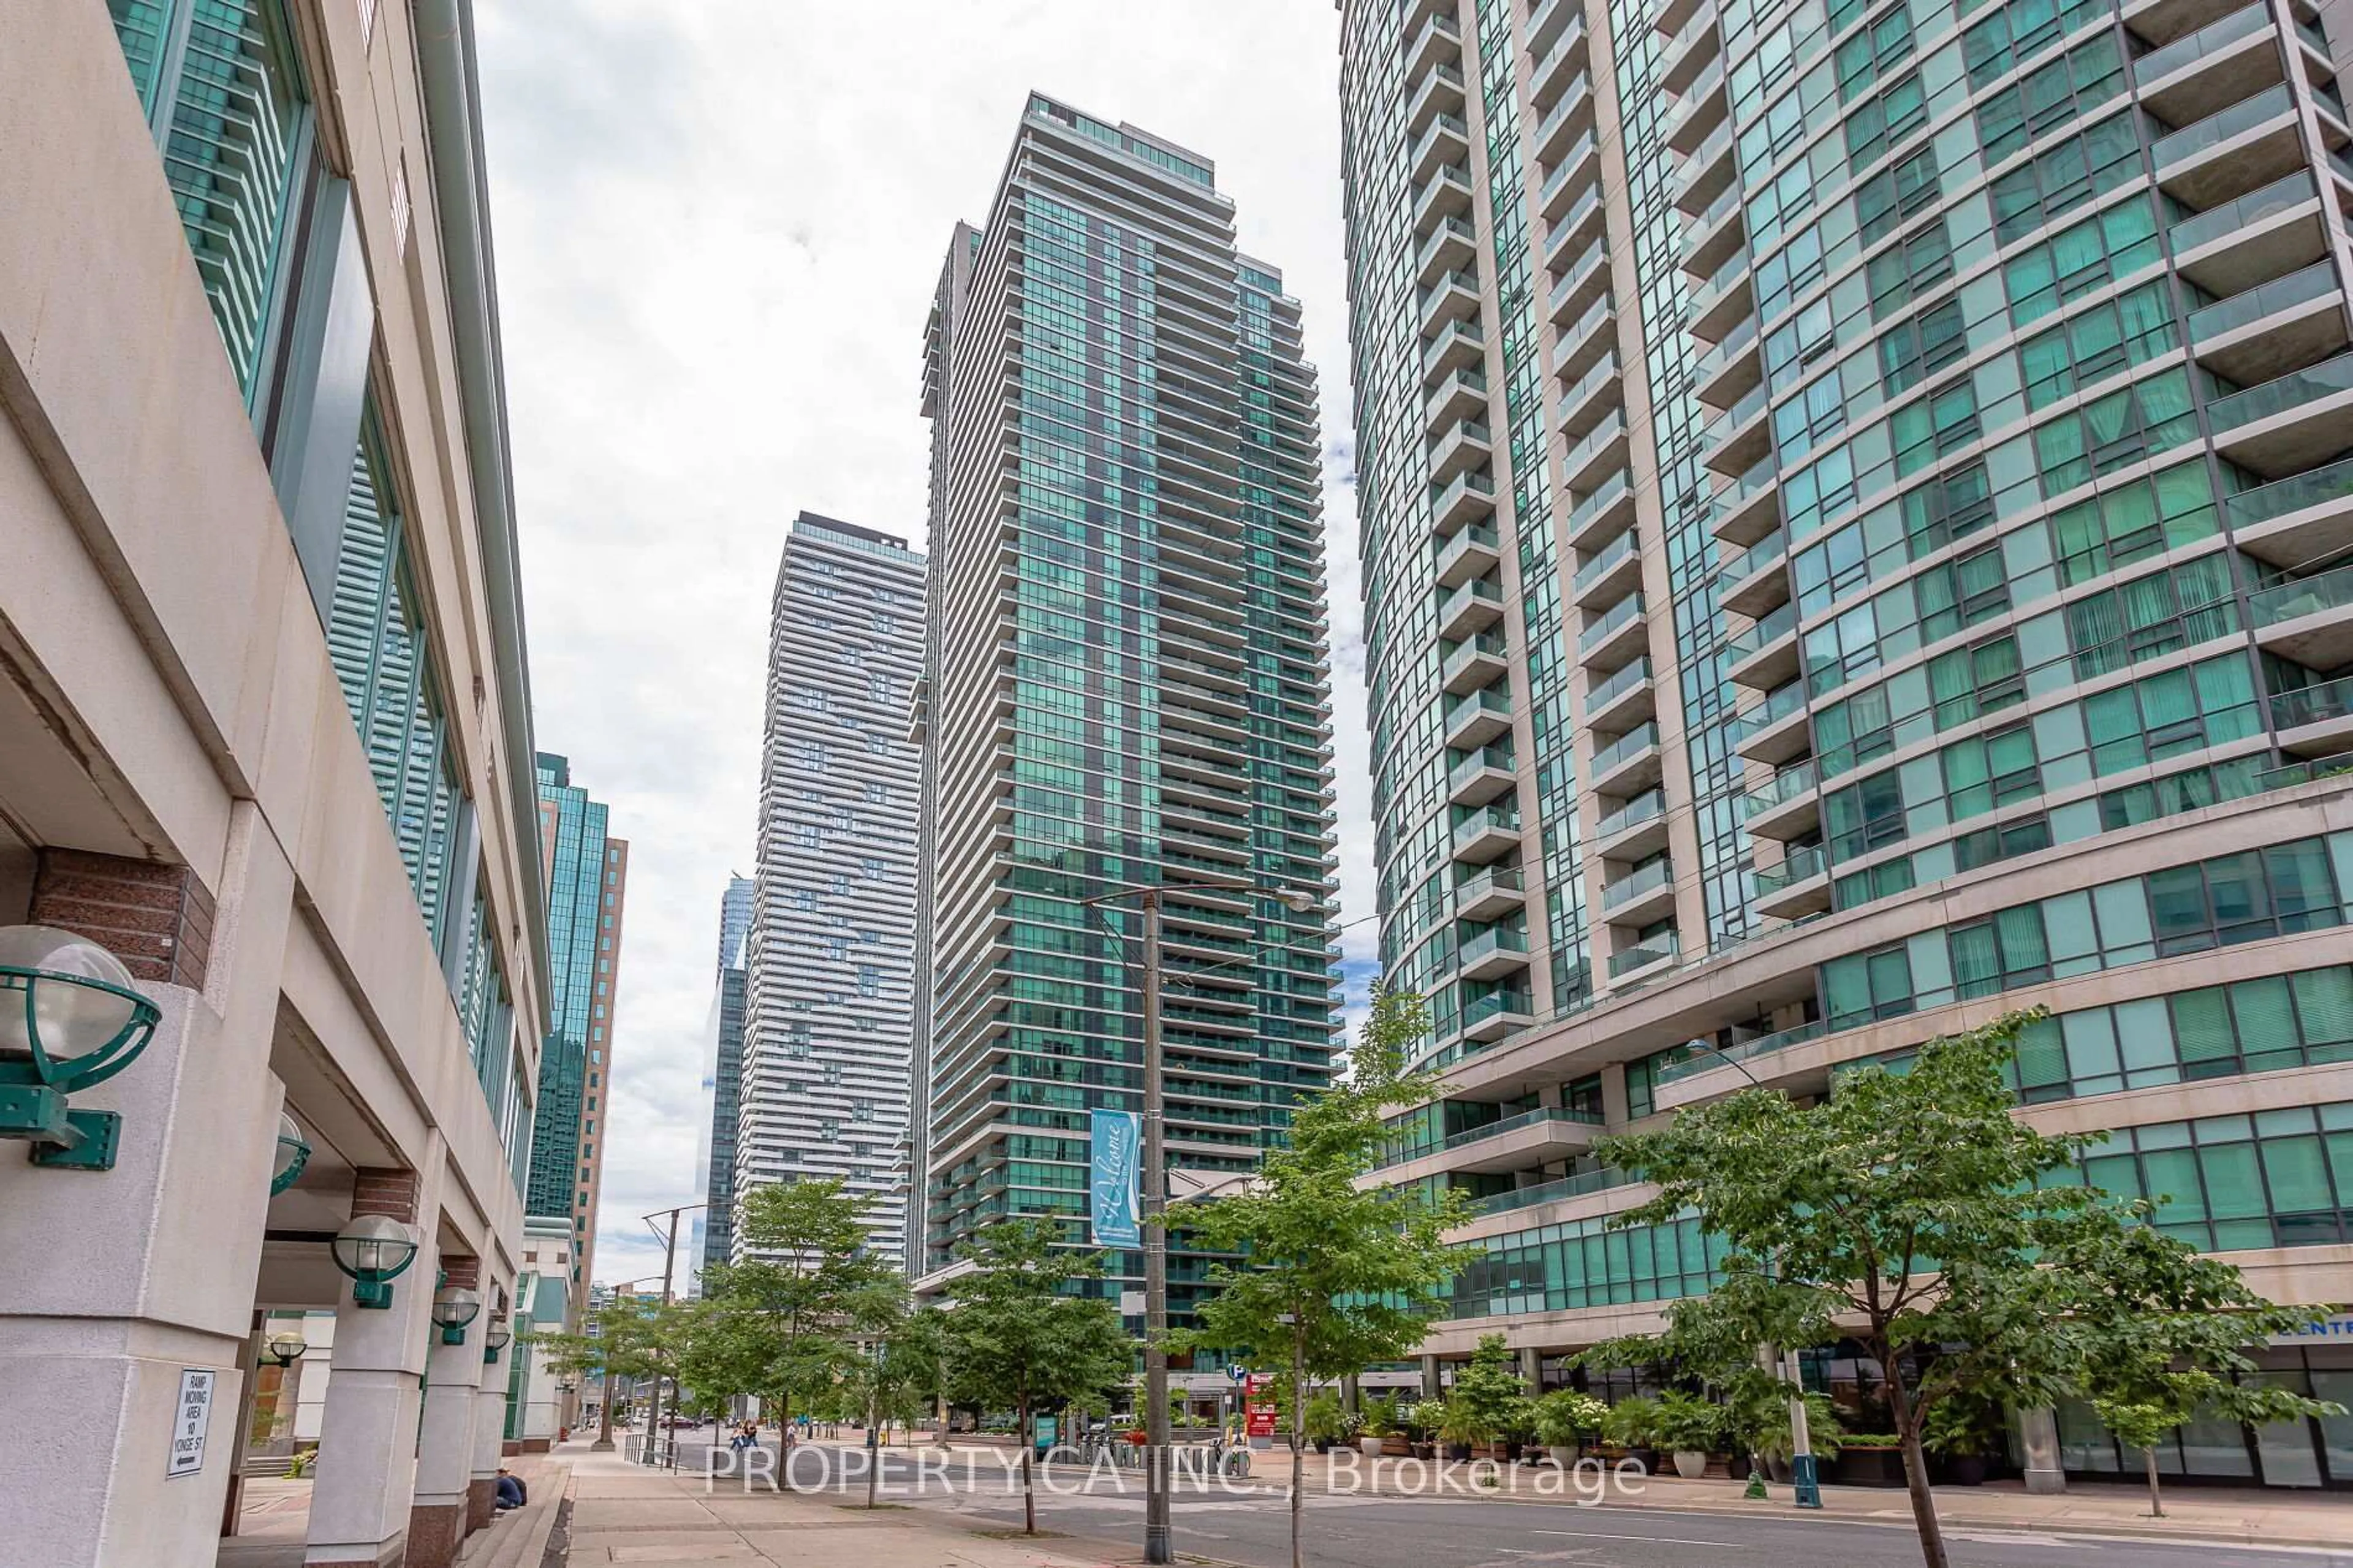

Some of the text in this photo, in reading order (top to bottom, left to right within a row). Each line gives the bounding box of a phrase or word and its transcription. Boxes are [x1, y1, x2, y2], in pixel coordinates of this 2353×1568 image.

[1096, 1120, 1123, 1219] Welcome
[189, 1375, 207, 1389] RAMP
[186, 1406, 201, 1419] AREA
